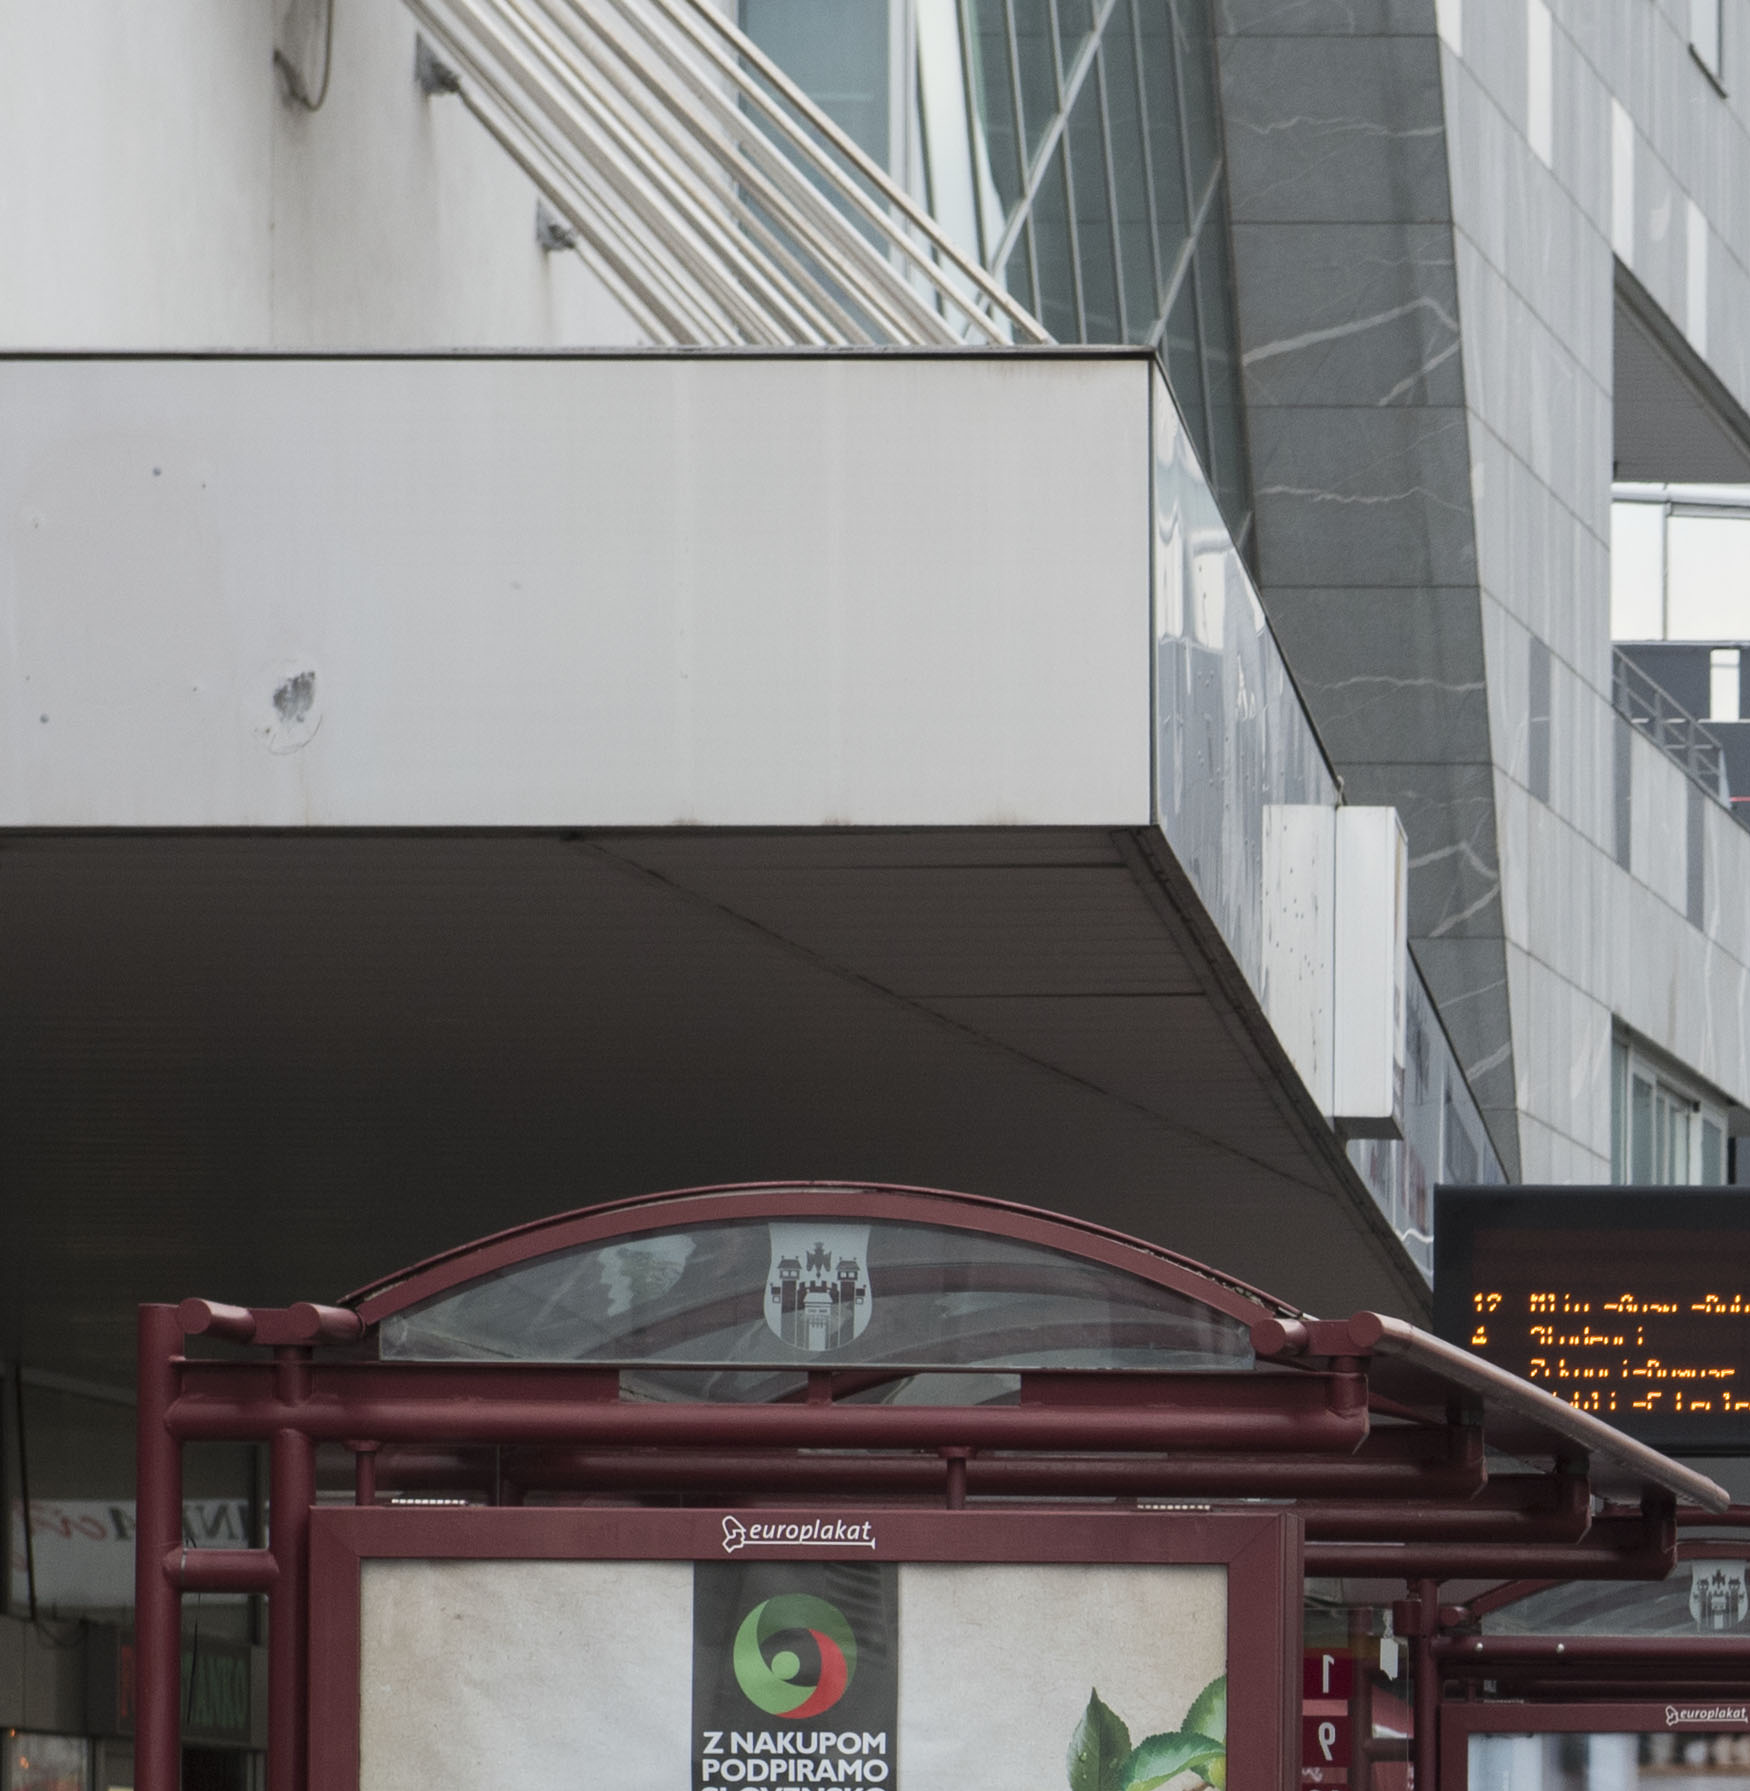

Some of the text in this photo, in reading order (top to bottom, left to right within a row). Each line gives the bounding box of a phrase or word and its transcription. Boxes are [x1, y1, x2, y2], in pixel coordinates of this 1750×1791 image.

[748, 1518, 874, 1546] europlakat
[1679, 1707, 1748, 1721] europlakat
[703, 1731, 887, 1754] Z NAKUPOM
[702, 1758, 889, 1782] PODPIRAMO
